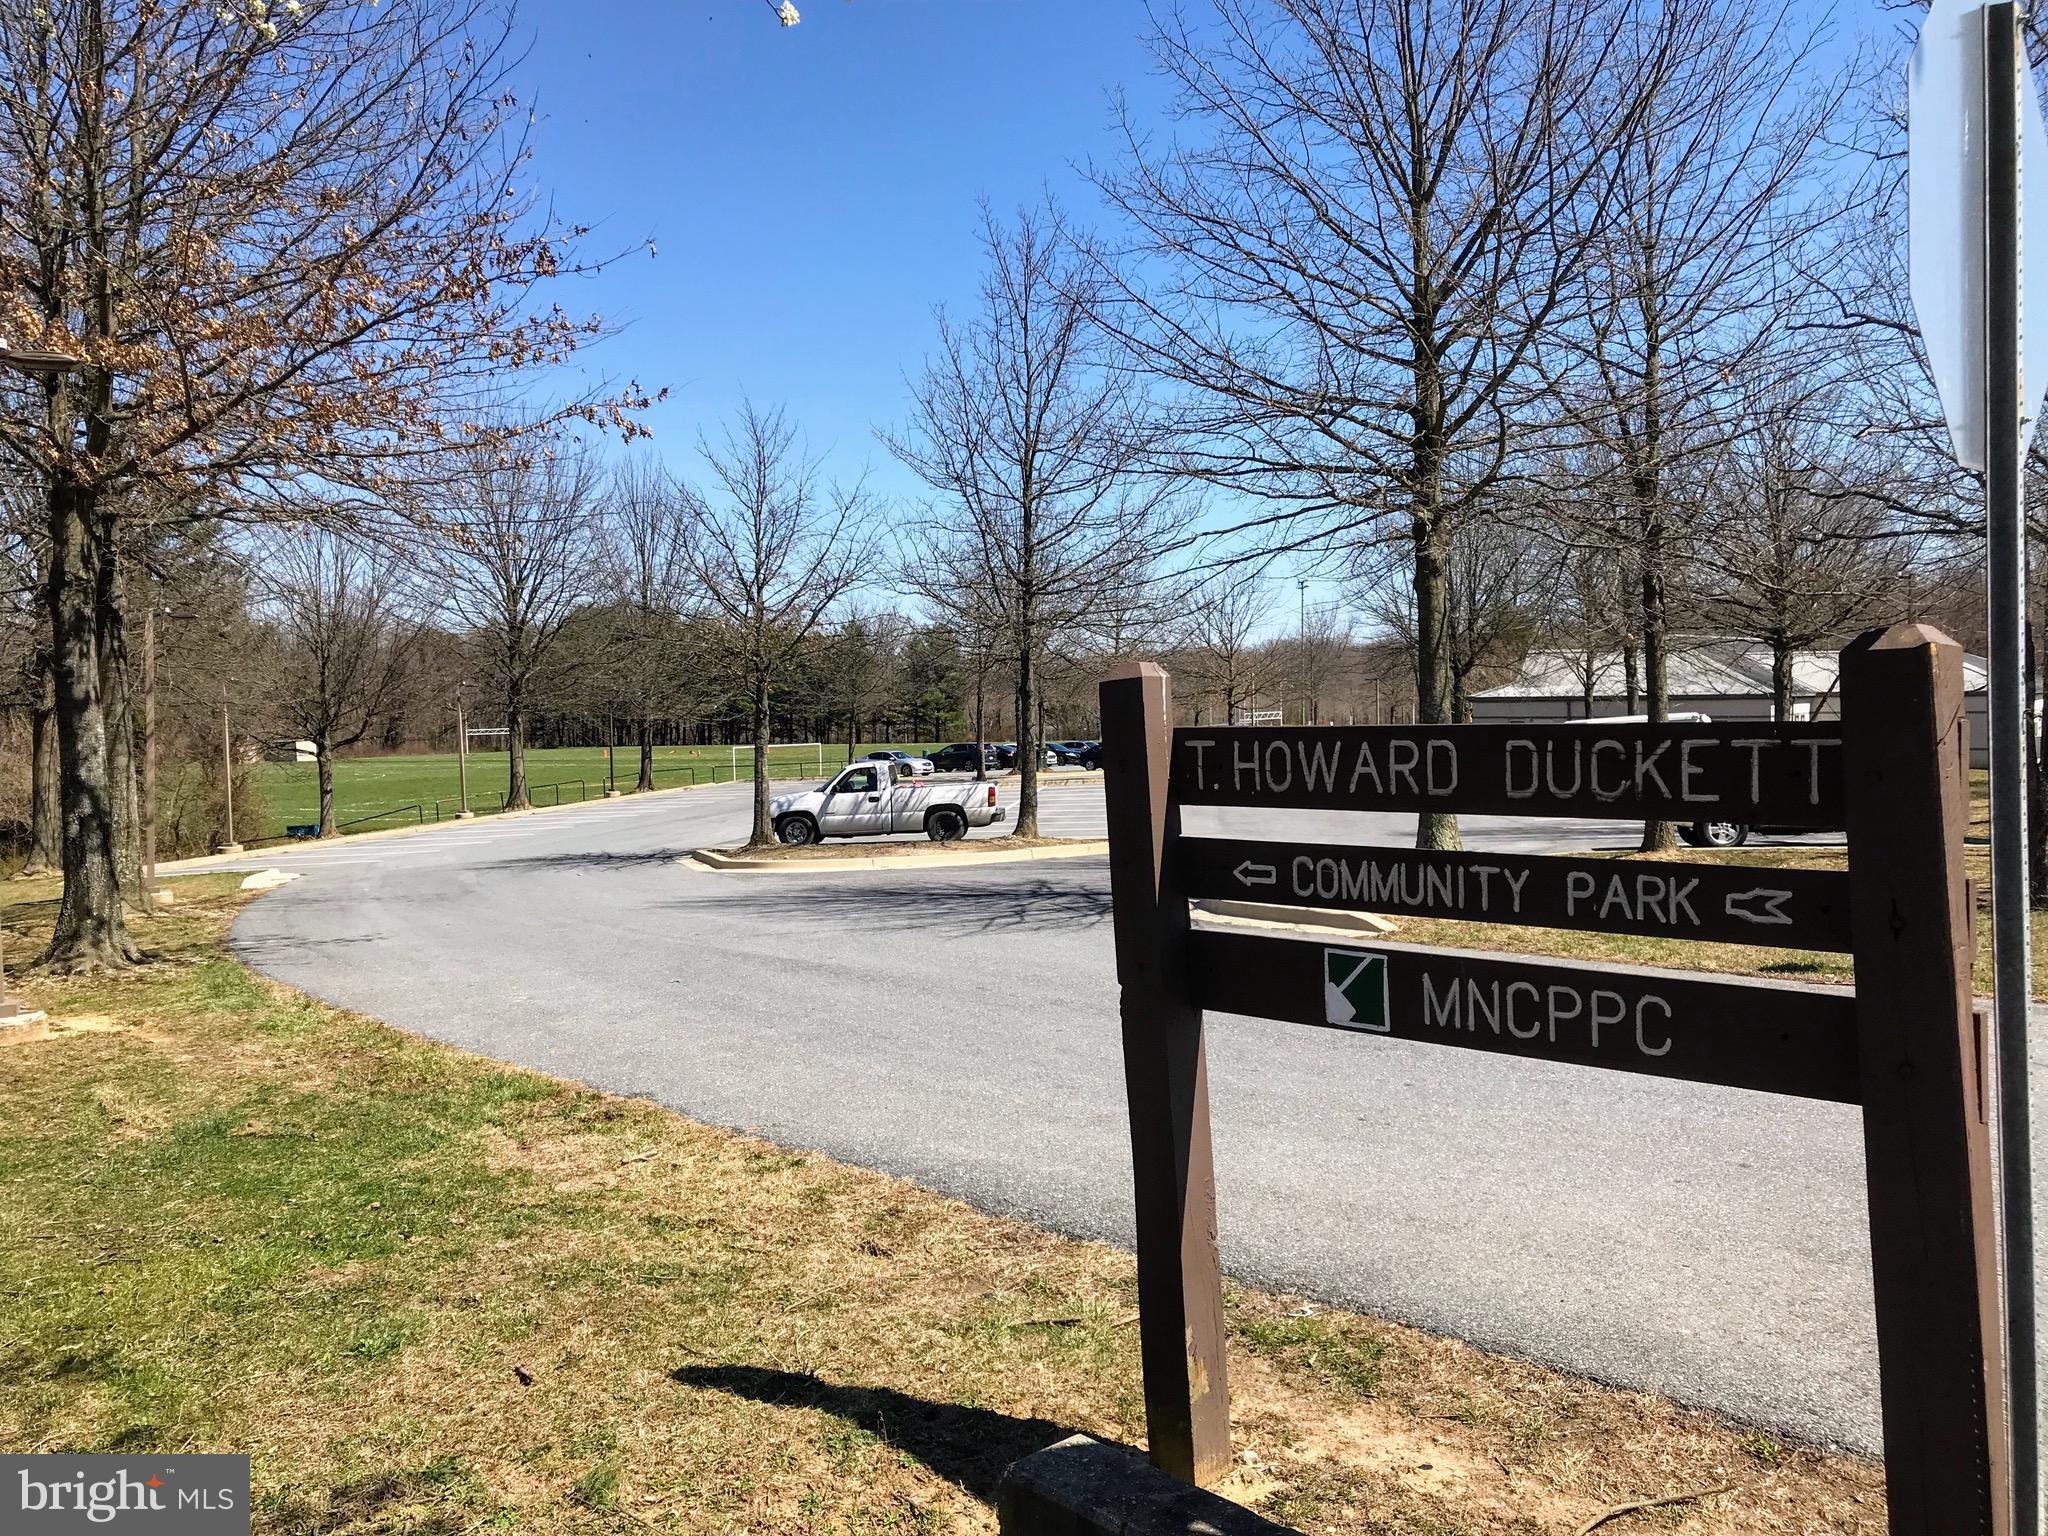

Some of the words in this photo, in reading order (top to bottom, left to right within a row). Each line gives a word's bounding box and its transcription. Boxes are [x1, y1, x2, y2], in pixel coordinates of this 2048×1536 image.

[1505, 738, 1842, 804] DUCKETT
[1292, 856, 1530, 912] COMMUNITY
[1566, 871, 1701, 926] PARK
[1422, 972, 1672, 1056] MNCPPC
